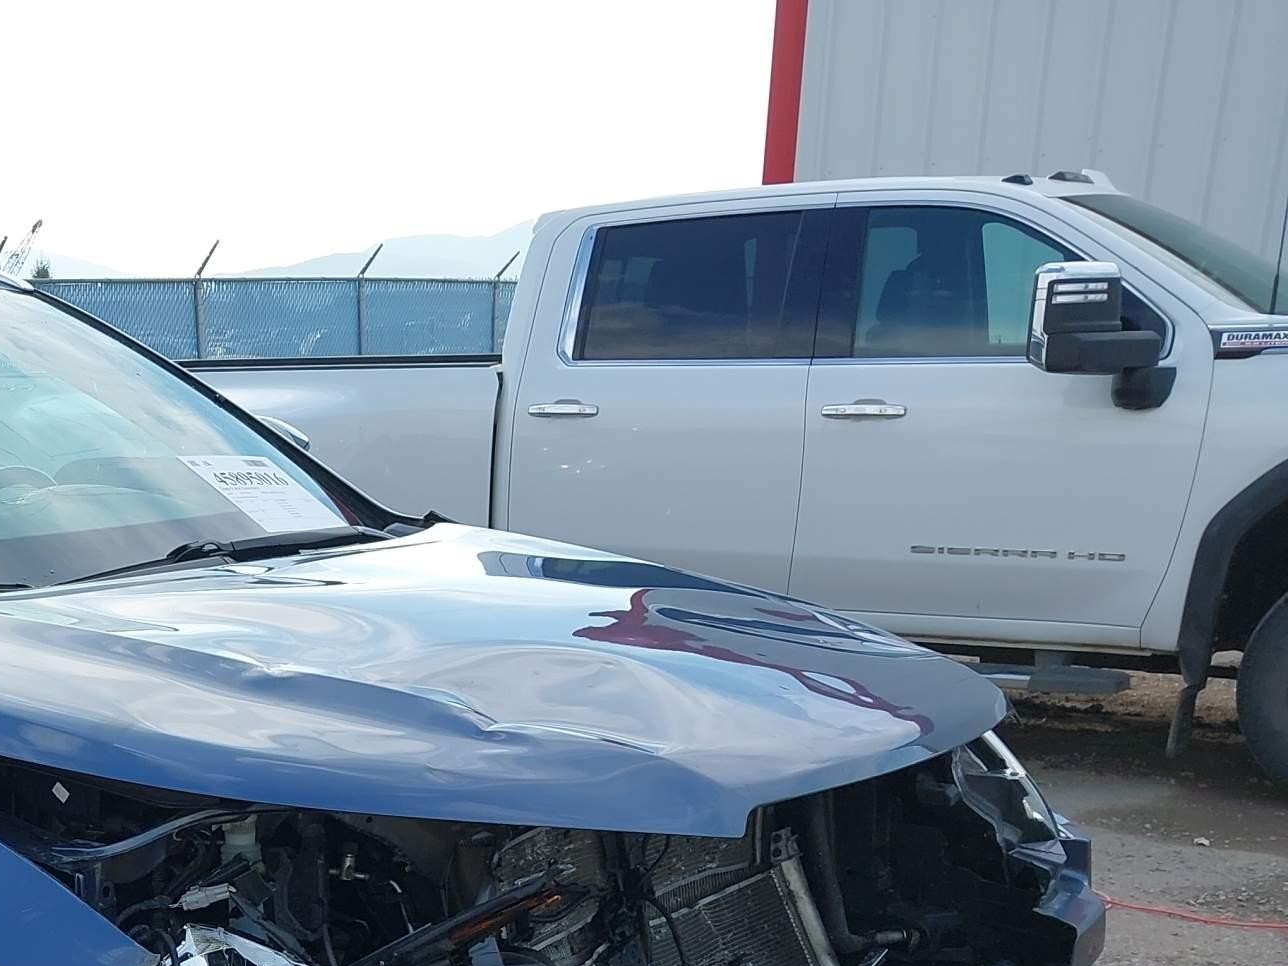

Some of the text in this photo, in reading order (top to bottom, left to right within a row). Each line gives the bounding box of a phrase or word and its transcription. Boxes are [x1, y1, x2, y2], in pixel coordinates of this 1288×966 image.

[213, 471, 289, 487] 45895016
[911, 545, 1126, 561] SIERRA HD
